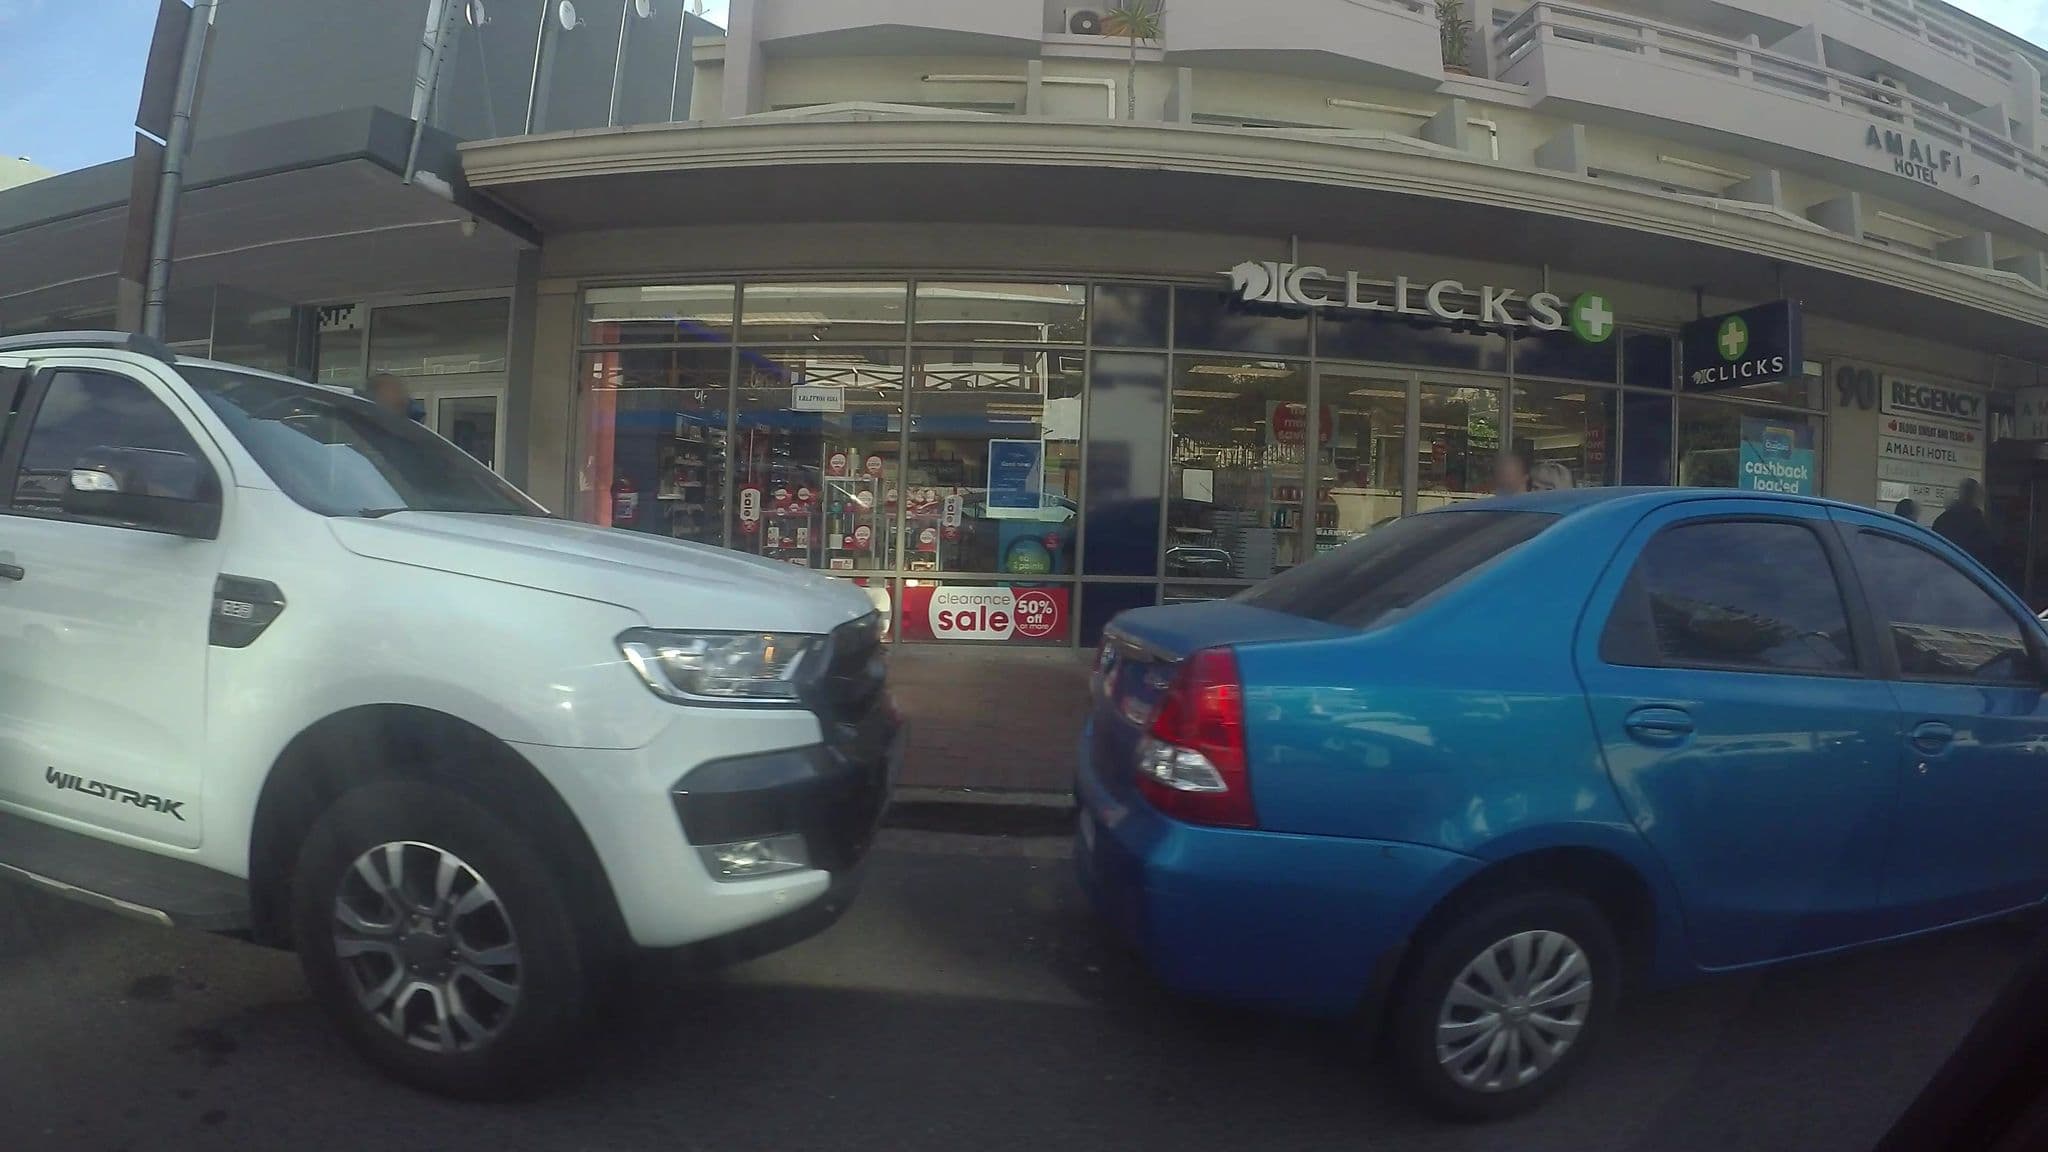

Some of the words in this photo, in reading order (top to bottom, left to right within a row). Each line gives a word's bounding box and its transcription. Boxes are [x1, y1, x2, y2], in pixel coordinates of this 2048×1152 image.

[1865, 125, 1962, 178] AMALFI
[1894, 157, 1938, 186] HOTEL
[1293, 265, 1564, 332] CLICKS
[1705, 355, 1785, 384] CLICKS
[1838, 366, 1875, 410] 90
[1891, 381, 1981, 417] REGENCY
[1886, 442, 1924, 457] AMALFI
[1927, 447, 1958, 463] HOTEL
[1745, 461, 1808, 480] cashback
[1753, 476, 1799, 494] loaded
[937, 592, 1010, 605] clearance
[1018, 600, 1053, 614] 50%
[938, 605, 1009, 632] sale
[1026, 614, 1042, 624] off
[46, 766, 185, 822] WILDTRAK
